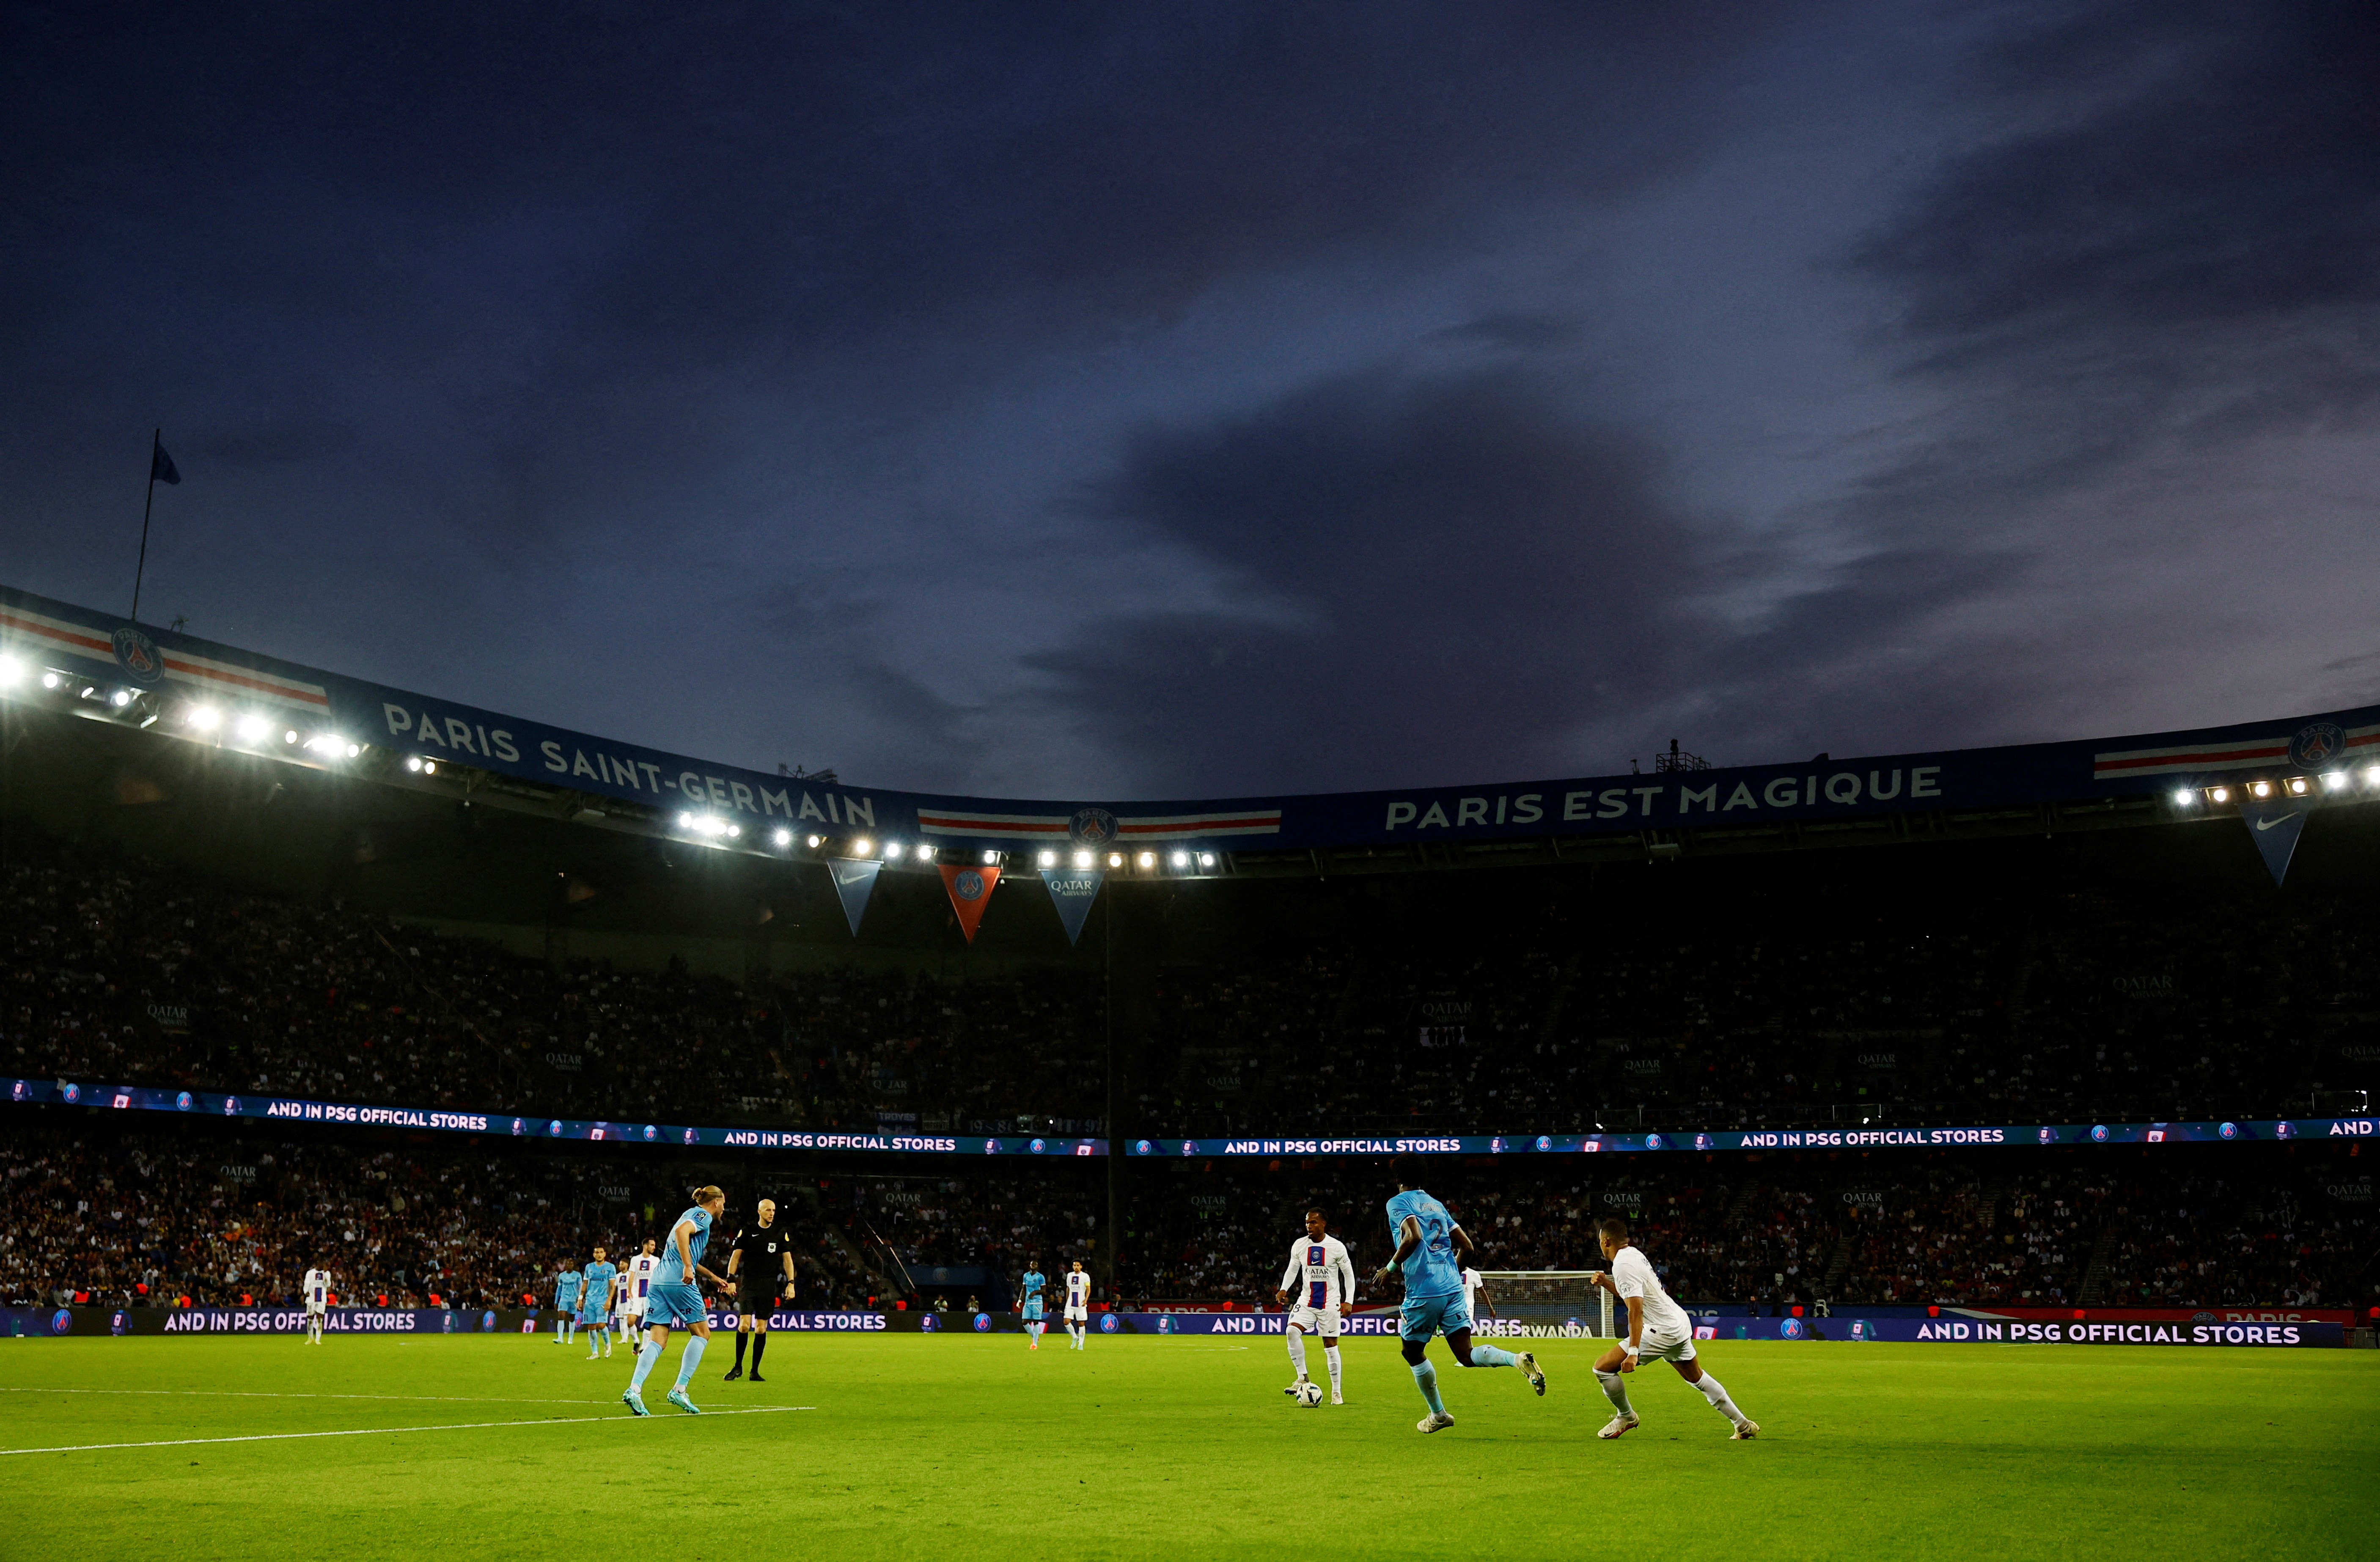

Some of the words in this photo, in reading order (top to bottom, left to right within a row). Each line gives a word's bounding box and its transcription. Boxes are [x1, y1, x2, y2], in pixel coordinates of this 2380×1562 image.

[382, 703, 520, 763] PARIS
[540, 740, 876, 827] SAINT-GERMAIN
[1385, 793, 1544, 830] PARIS
[1564, 786, 1663, 821] EST
[1679, 766, 1942, 814] MAGIQUE
[1051, 880, 1092, 892] QATAR
[2113, 975, 2173, 993] QATAR
[148, 1004, 187, 1019] QATAR
[1422, 1001, 1472, 1017] QATAR
[546, 1052, 581, 1065] QATAR
[1625, 1060, 1660, 1071] QATAR
[1858, 1054, 1896, 1065] QATAR
[267, 1102, 302, 1117] AND
[305, 1104, 322, 1119] IN
[326, 1106, 356, 1121] PSG
[360, 1108, 427, 1126] OFFICIAL
[430, 1113, 486, 1130] STORES
[879, 1113, 916, 1121] TROYES
[2330, 1121, 2372, 1135] AND
[724, 1132, 758, 1145] AND
[762, 1133, 778, 1145] IN
[782, 1134, 813, 1147] PSG
[817, 1135, 888, 1149] OFFICIAL
[892, 1138, 955, 1151] STORES
[1741, 1134, 1778, 1147] AND
[1783, 1134, 1800, 1146] IN
[1806, 1133, 1841, 1145] PSG
[1846, 1131, 1927, 1145] OFFICIAL
[1931, 1129, 2004, 1143] STORES
[1225, 1142, 1259, 1153] AND
[1264, 1141, 1280, 1153] IN
[1285, 1141, 1316, 1153] PSG
[1320, 1140, 1393, 1153] OFFICIAL
[1396, 1139, 1460, 1152] STORES
[599, 1186, 629, 1197] QATAR
[2327, 1185, 2372, 1197] QATAR
[886, 1193, 921, 1204] QATAR
[1191, 1197, 1226, 1207] QATAR
[1604, 1193, 1641, 1205] QATAR
[1843, 1193, 1882, 1204] QATAR
[1429, 1219, 1443, 1249] 2
[164, 1313, 205, 1331] AND
[210, 1313, 229, 1330] IN
[234, 1312, 270, 1330] PSG
[275, 1312, 349, 1330] OFFIAL
[353, 1313, 415, 1330] STORES
[723, 1314, 810, 1329] OCIAL
[814, 1315, 886, 1329] STORES
[1212, 1318, 1255, 1332] AND
[1261, 1318, 1281, 1332] IN
[1522, 1325, 1592, 1337] RWANDA
[1917, 1323, 1969, 1339] AND
[1978, 1323, 2001, 1340] IN
[2011, 1324, 2061, 1340] PSG
[2069, 1324, 2187, 1342] OFFICIAL
[2193, 1326, 2300, 1344] STORES
